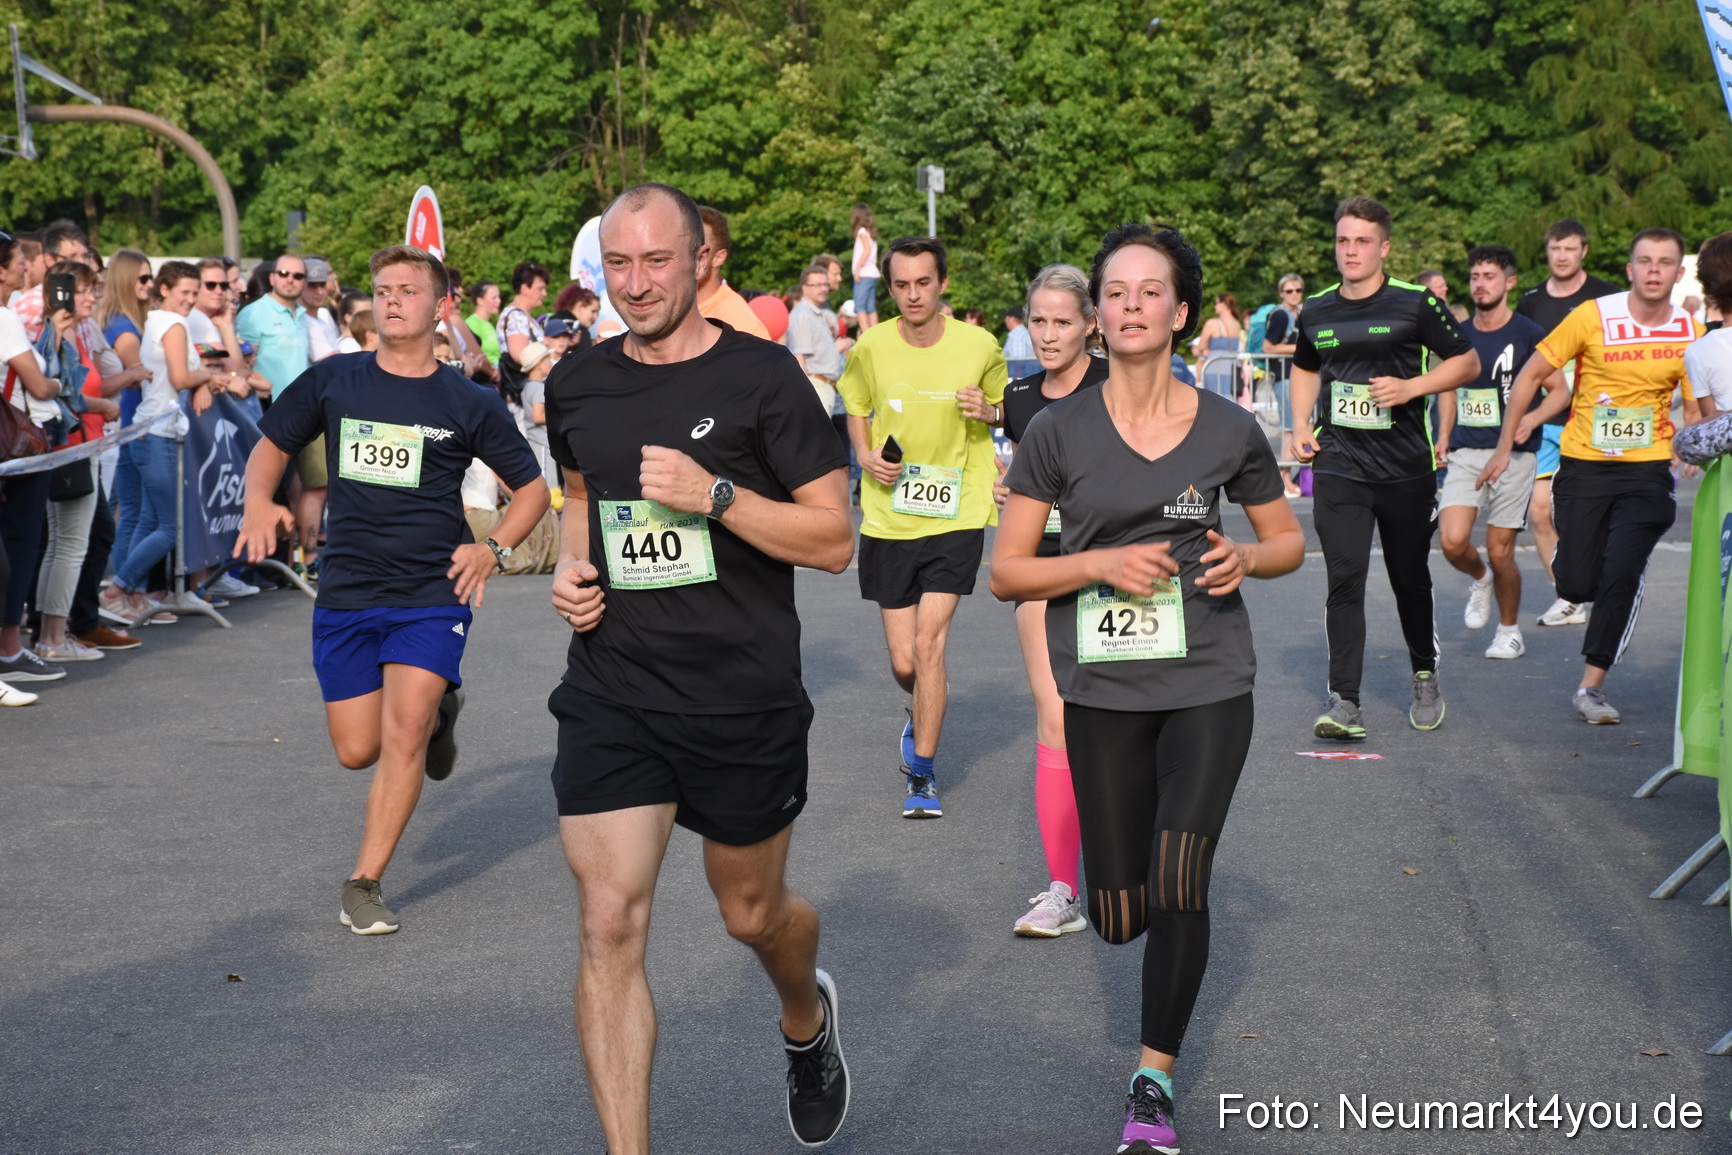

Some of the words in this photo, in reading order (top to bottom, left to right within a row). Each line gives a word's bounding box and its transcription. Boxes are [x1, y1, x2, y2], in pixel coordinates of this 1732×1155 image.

[1317, 329, 1333, 338] JAKO
[1368, 326, 1390, 334] ROBIN
[1604, 350, 1645, 363] MAX
[1338, 398, 1379, 417] 2101
[1461, 402, 1492, 416] 1948
[1600, 422, 1645, 437] 1643
[350, 442, 409, 469] 1399
[359, 465, 380, 473] Grimm
[901, 481, 951, 503] 1206
[677, 517, 699, 527] 2019
[621, 530, 682, 565] 440
[622, 565, 650, 575] Schmid
[652, 562, 690, 574] Stephan
[643, 573, 671, 582] Ingenieur
[672, 570, 692, 578] GmbH
[1156, 598, 1176, 606] 2019
[1097, 607, 1159, 637] 425
[1101, 639, 1130, 648] Regnet
[1132, 637, 1159, 646] Emma
